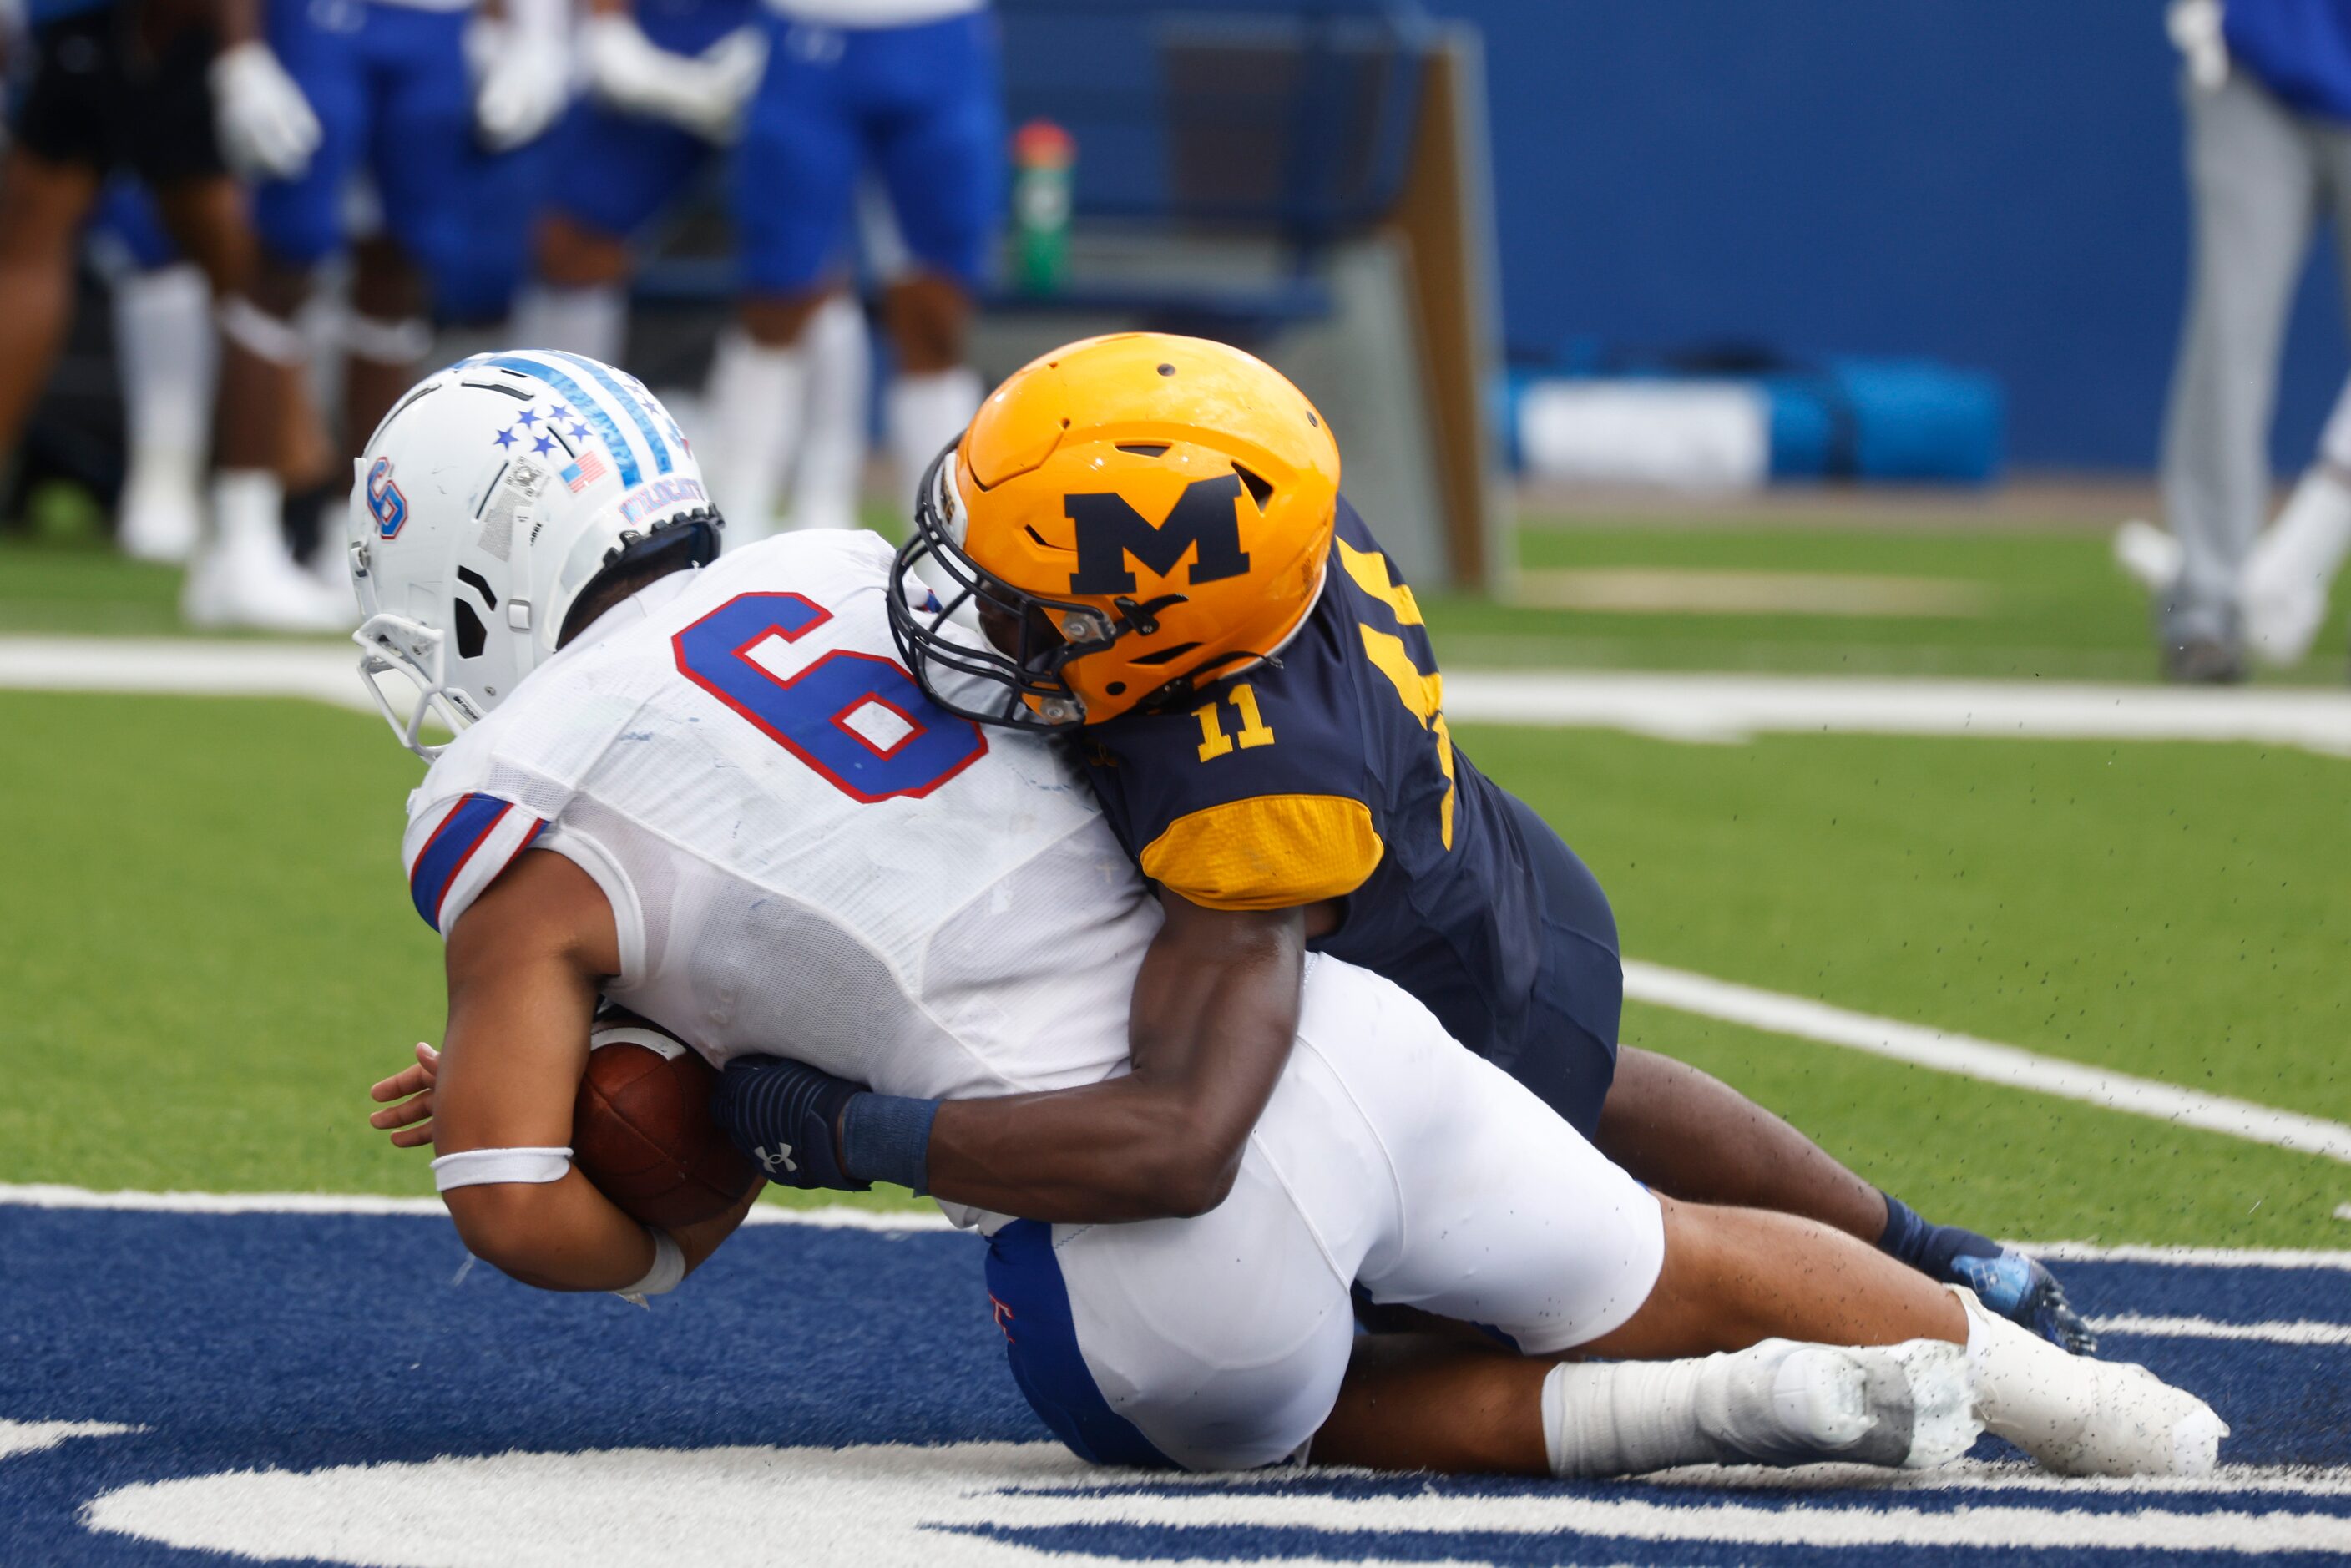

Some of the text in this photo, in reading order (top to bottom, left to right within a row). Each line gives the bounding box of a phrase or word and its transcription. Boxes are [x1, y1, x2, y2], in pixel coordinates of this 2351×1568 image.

[367, 457, 407, 539] 6
[1064, 474, 1250, 594] M
[671, 591, 989, 804] 6
[1191, 683, 1275, 762] 11
